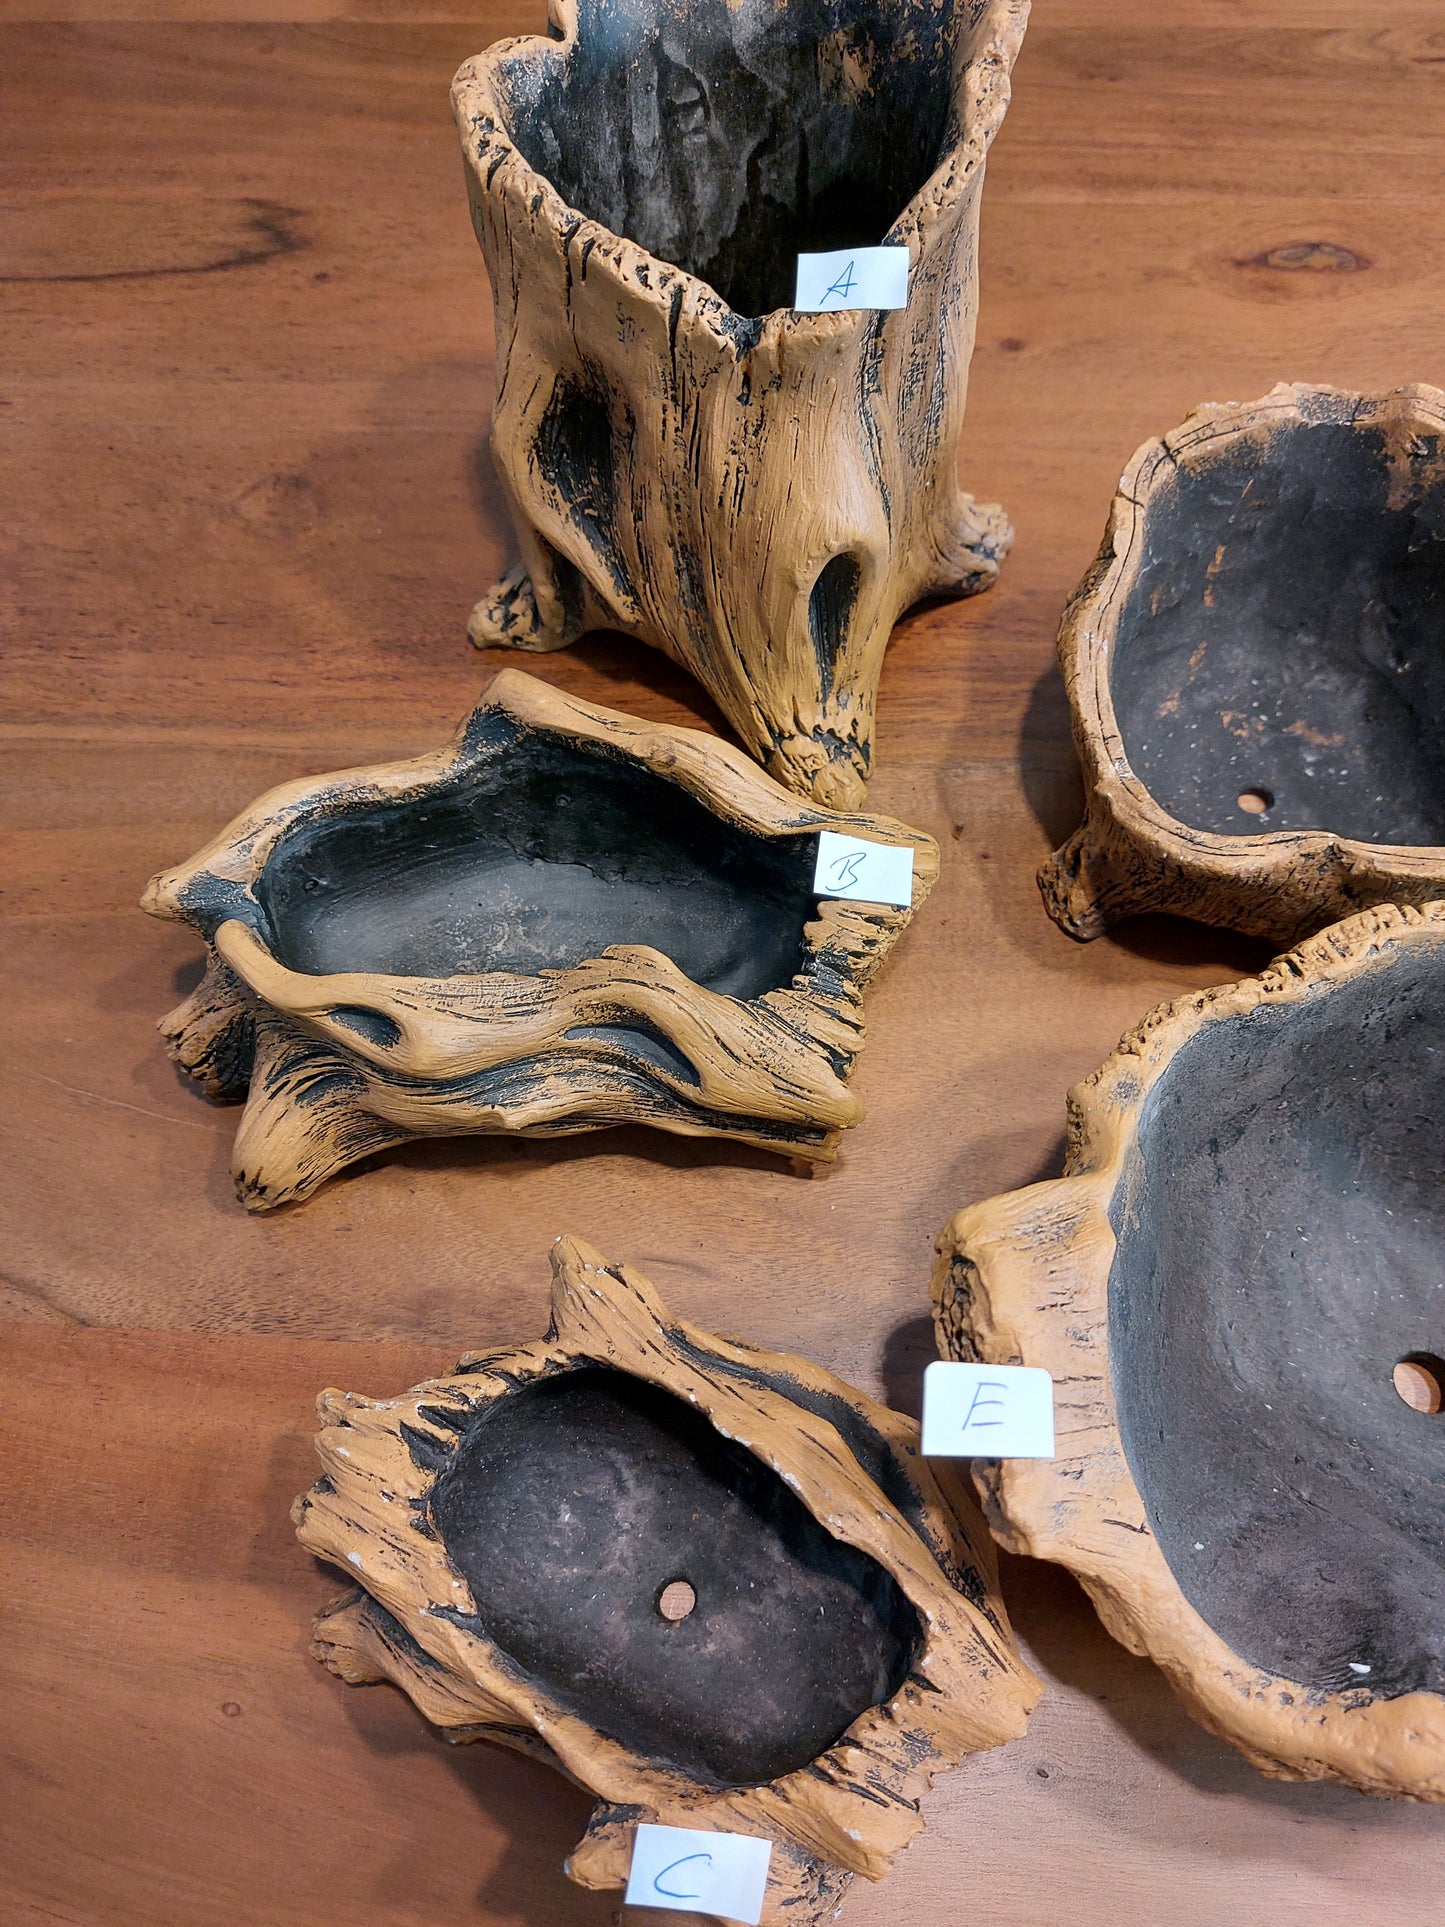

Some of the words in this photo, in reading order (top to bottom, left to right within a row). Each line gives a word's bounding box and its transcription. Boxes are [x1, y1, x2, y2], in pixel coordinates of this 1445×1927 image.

[819, 260, 859, 304] A
[824, 851, 867, 892] B
[961, 1382, 1007, 1431] E
[653, 1853, 713, 1899] C
